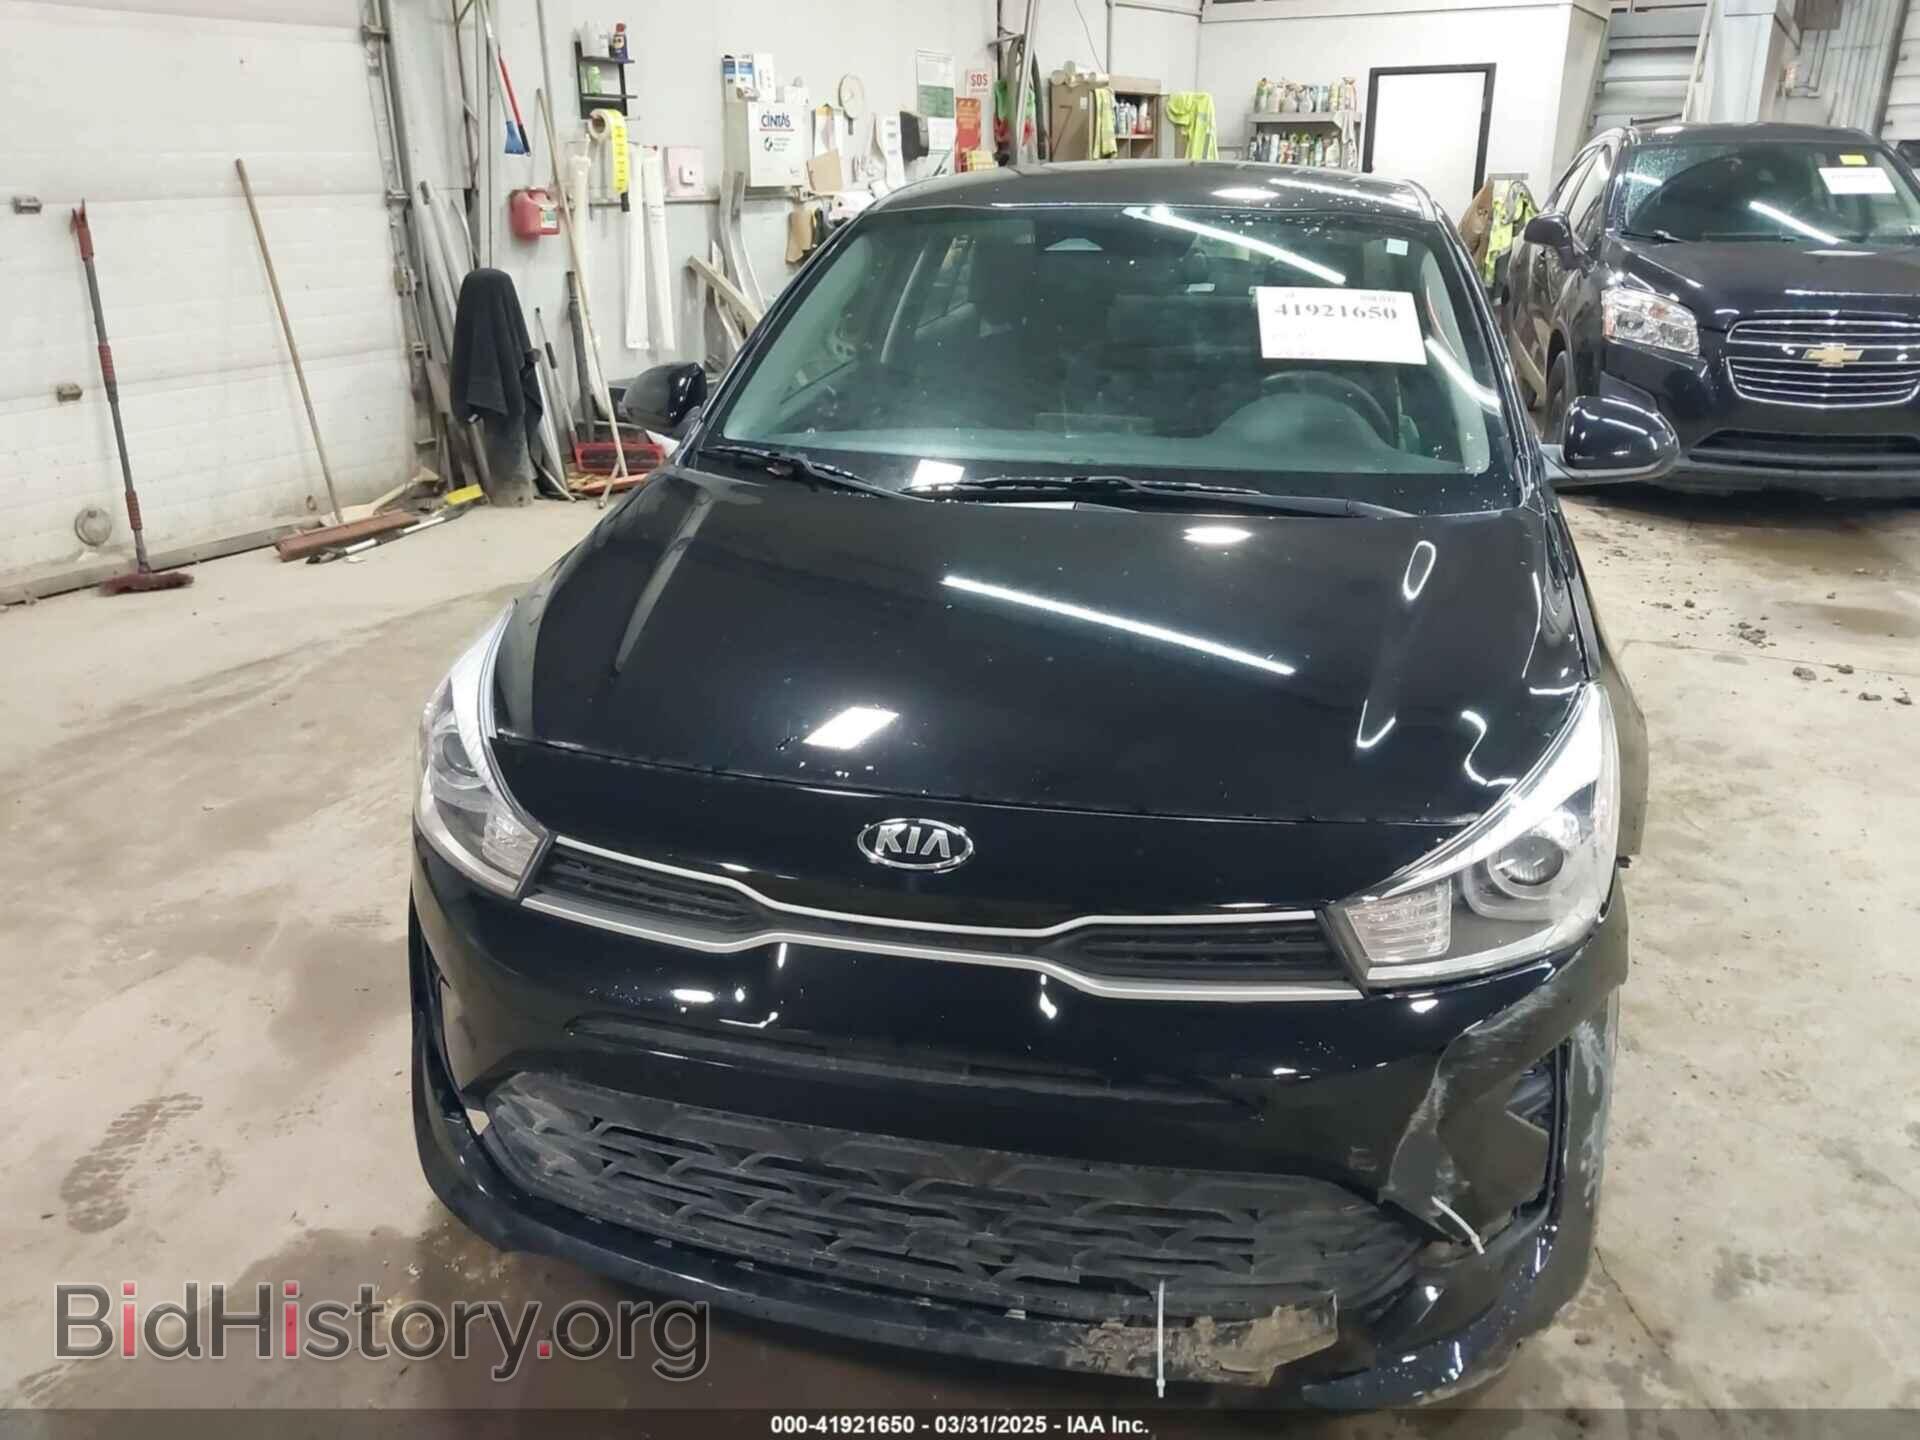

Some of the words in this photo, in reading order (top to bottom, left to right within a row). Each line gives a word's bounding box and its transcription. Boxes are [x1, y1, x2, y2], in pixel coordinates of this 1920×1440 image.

[970, 73, 988, 87] SOS
[1274, 303, 1397, 319] 41921650
[875, 823, 951, 858] KIA
